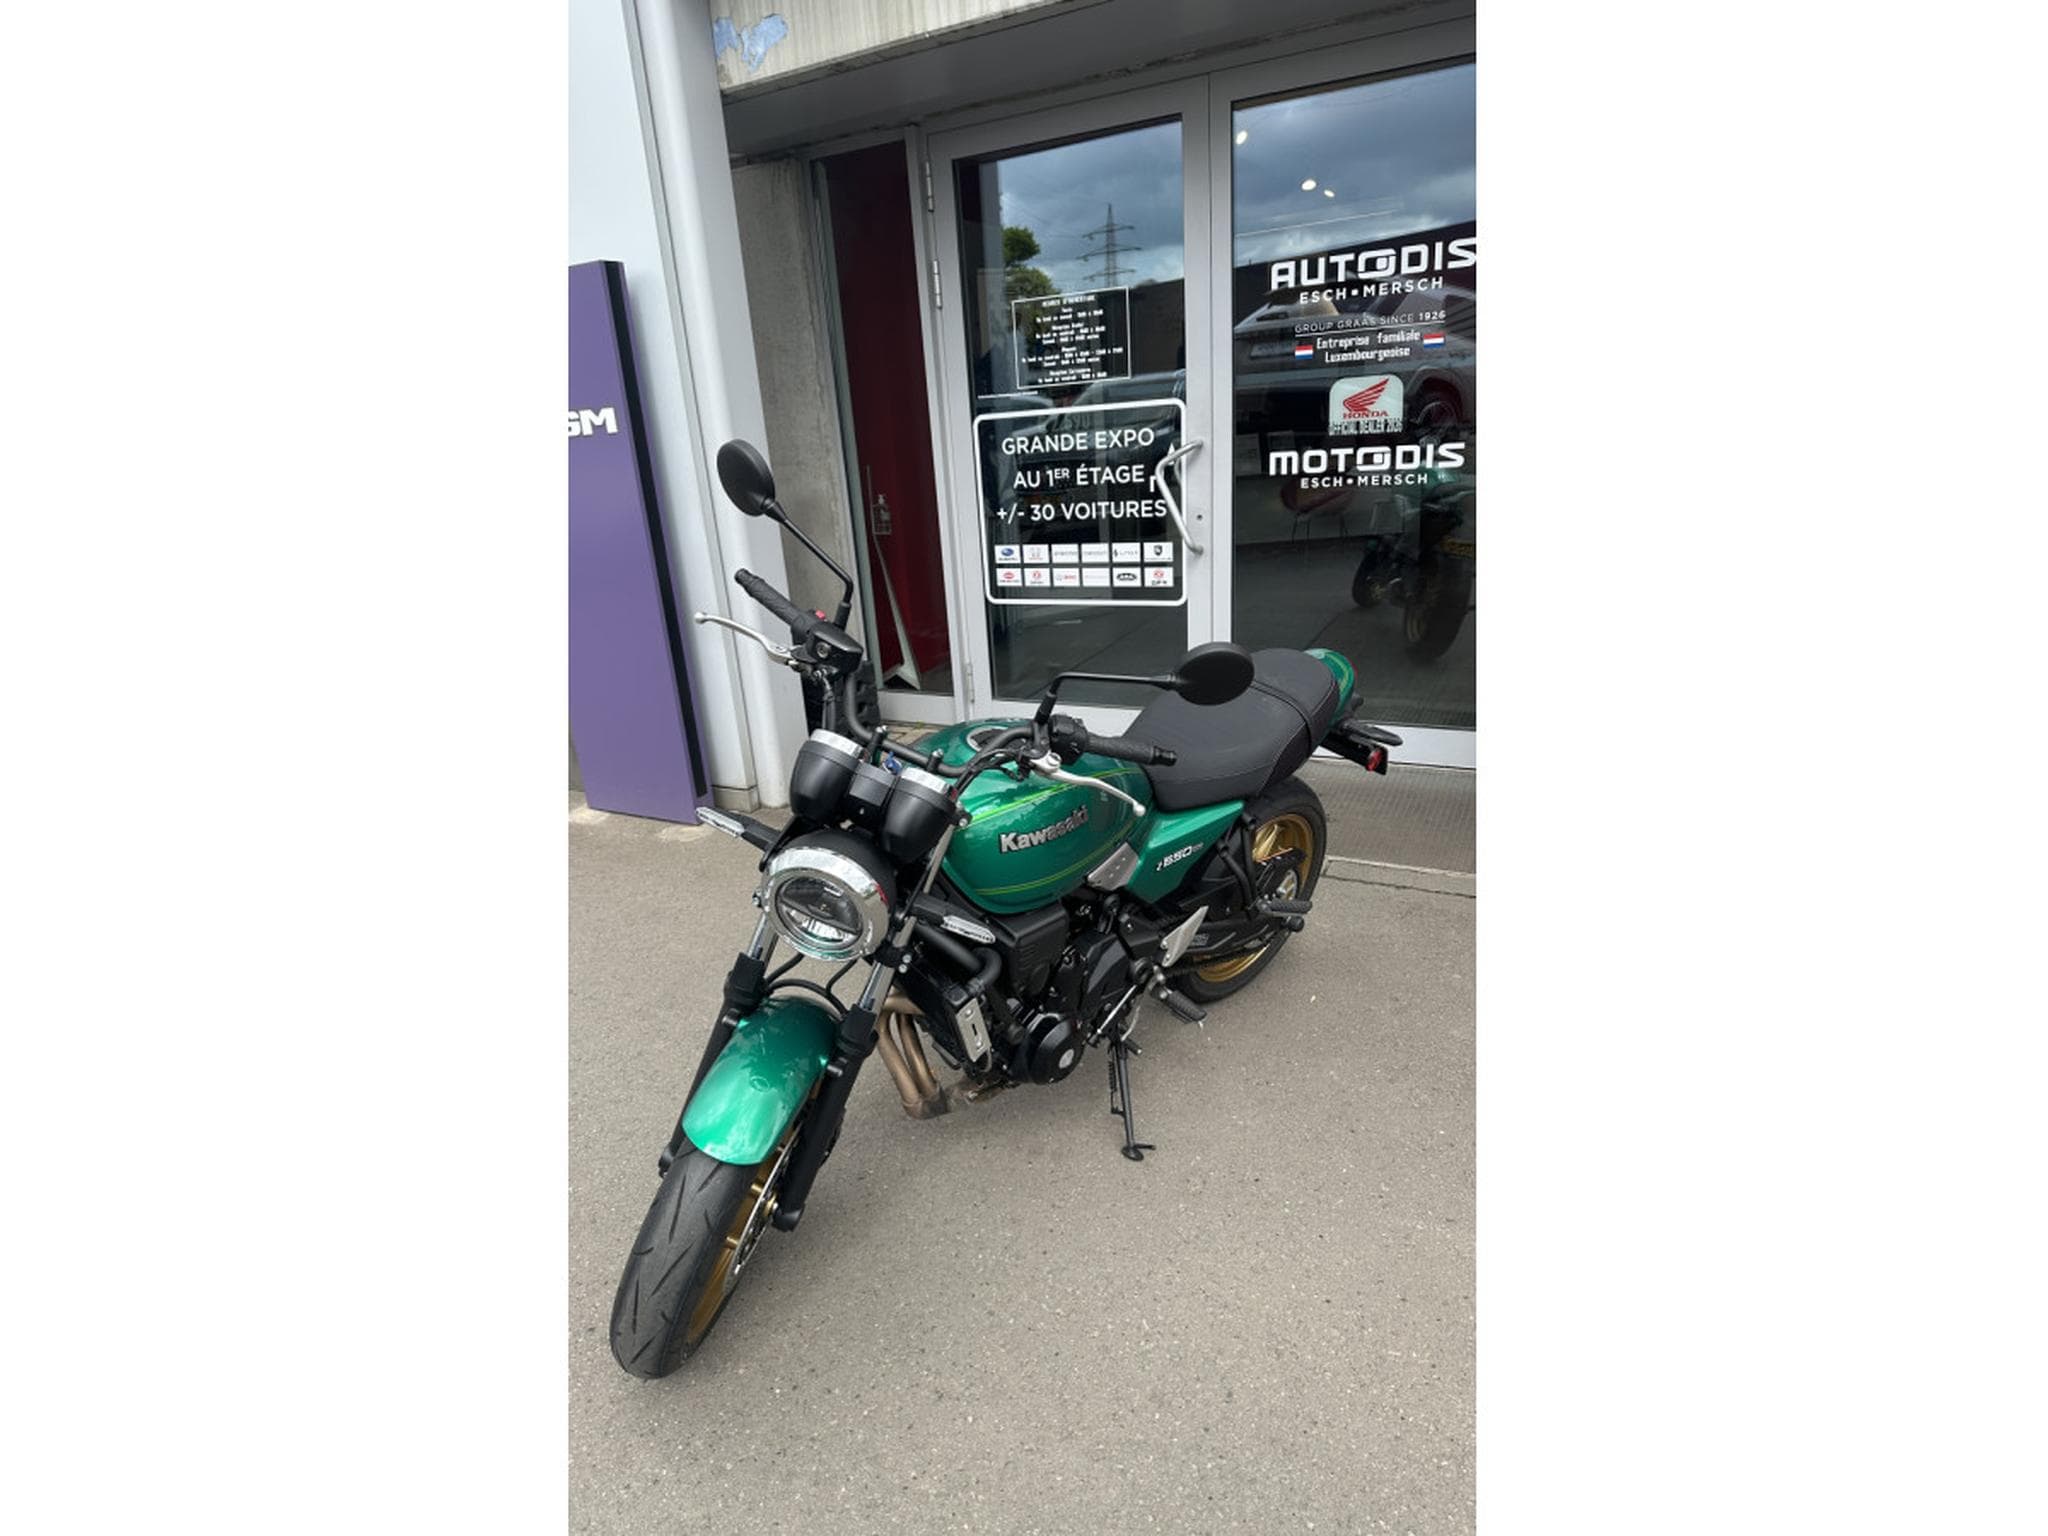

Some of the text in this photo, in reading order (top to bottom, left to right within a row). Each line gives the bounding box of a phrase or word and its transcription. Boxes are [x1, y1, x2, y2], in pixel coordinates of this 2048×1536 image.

[1271, 237, 1476, 290] AUTODIS
[1295, 311, 1446, 334] GROUP GRAAS SINCE 1926
[1316, 329, 1421, 350] Entreprise familiale
[1325, 346, 1411, 363] Luxembourgeoise
[1343, 410, 1388, 420] HONDA
[1002, 428, 1154, 455] GRANDE EXPO
[1269, 442, 1466, 476] MOTODIS
[1014, 470, 1040, 489] AU
[1076, 463, 1145, 486] ÉTAGE
[1030, 504, 1055, 521] 30
[1061, 500, 1167, 520] VOITURES
[1000, 803, 1090, 852] Kawasaki
